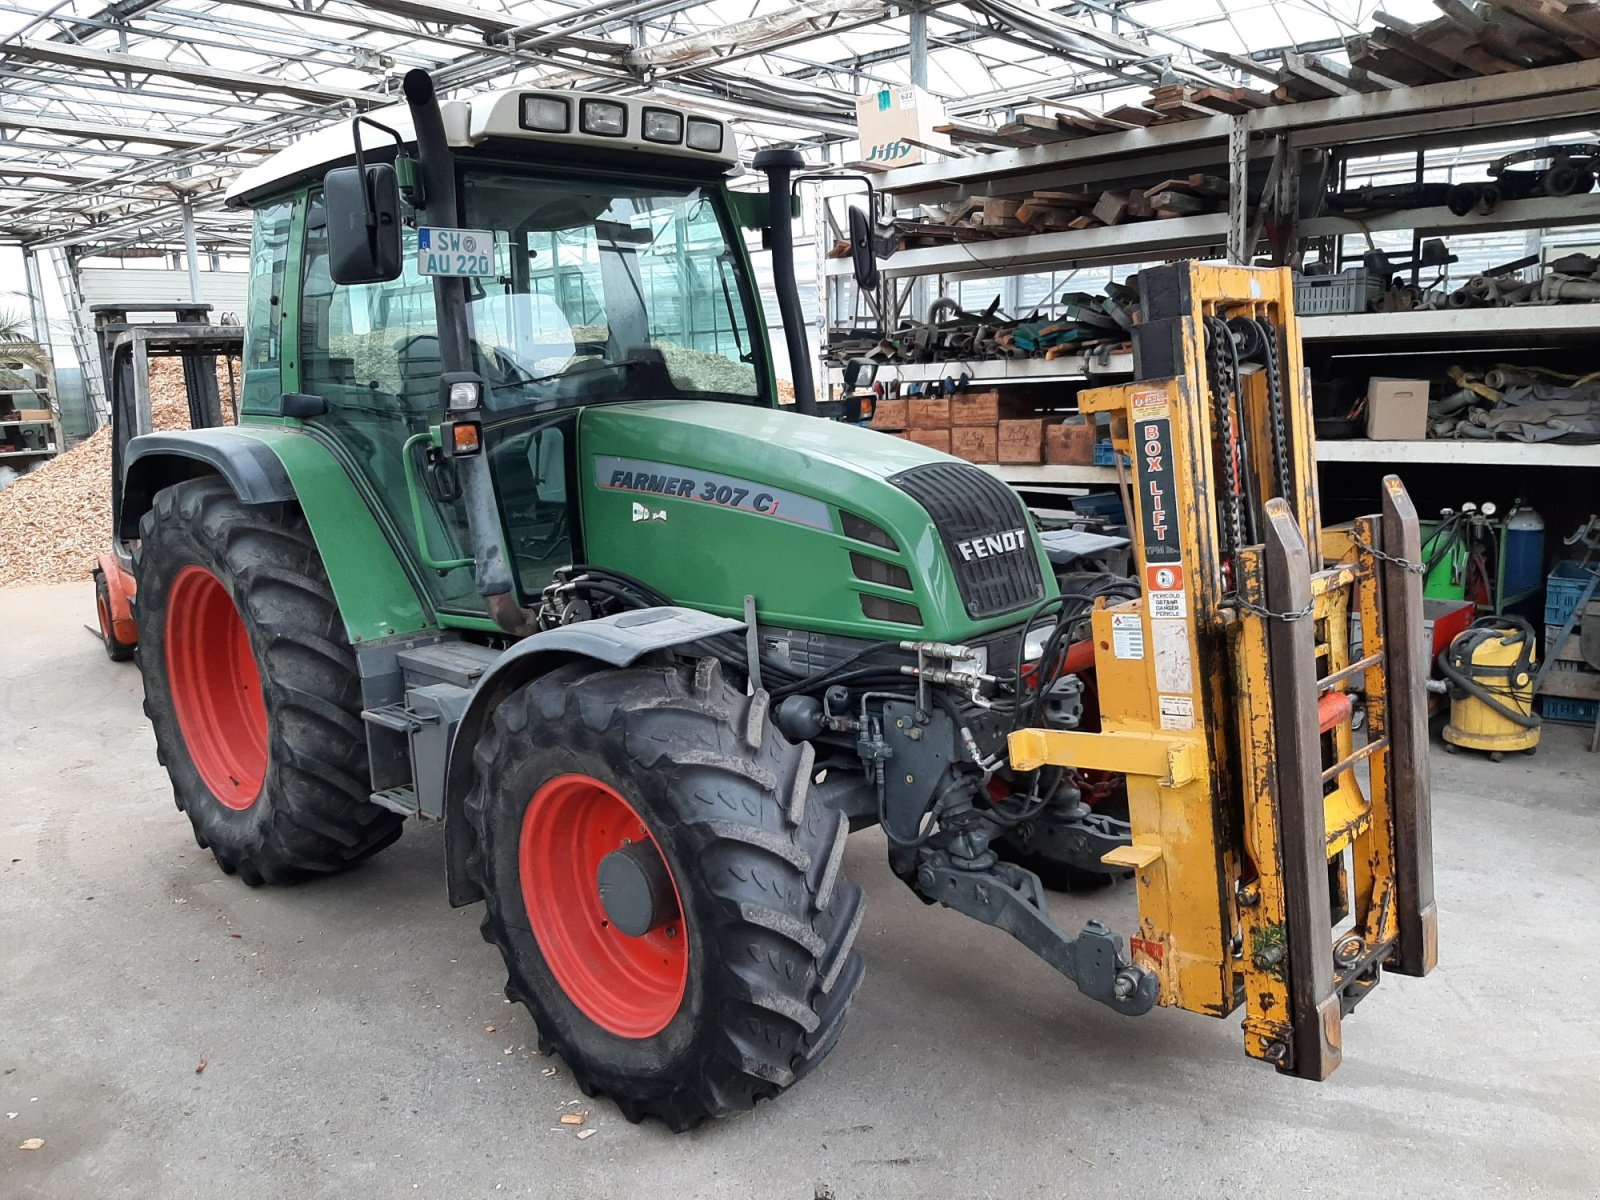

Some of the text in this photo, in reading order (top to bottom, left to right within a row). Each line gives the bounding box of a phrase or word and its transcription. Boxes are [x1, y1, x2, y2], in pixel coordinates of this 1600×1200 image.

[866, 140, 912, 161] Jiffy
[422, 241, 428, 249] D
[437, 231, 460, 252] SW
[426, 253, 489, 275] AU 220
[1144, 424, 1163, 473] BOX
[609, 470, 780, 516] FARMER 307 Ci
[1149, 480, 1168, 541] LIFT
[958, 529, 1026, 561] FENDT
